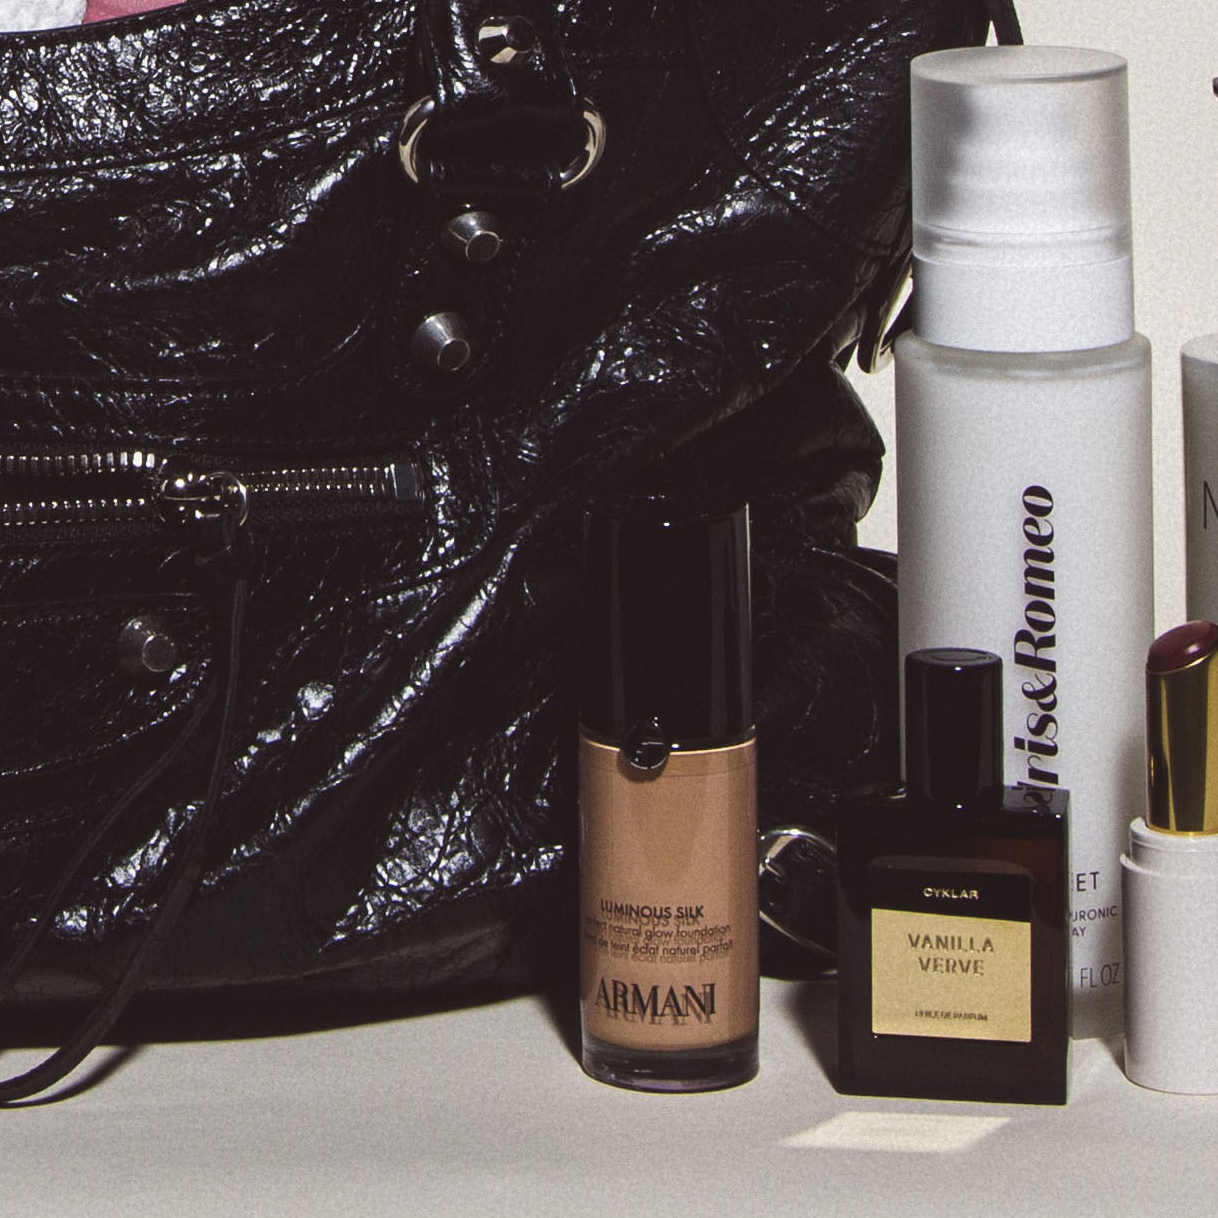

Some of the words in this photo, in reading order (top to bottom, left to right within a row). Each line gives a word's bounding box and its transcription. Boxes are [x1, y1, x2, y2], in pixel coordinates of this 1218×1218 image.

[1071, 871, 1100, 892] ET
[922, 887, 979, 900] CYKLAR
[600, 899, 672, 919] LUMINOUS
[676, 905, 704, 919] SILK
[645, 925, 673, 941] glow
[908, 933, 995, 953] VANILLA
[918, 957, 985, 976] VERVE
[1080, 967, 1098, 988] FL
[1100, 963, 1120, 986] OZ
[595, 977, 716, 1018] ARMANI
